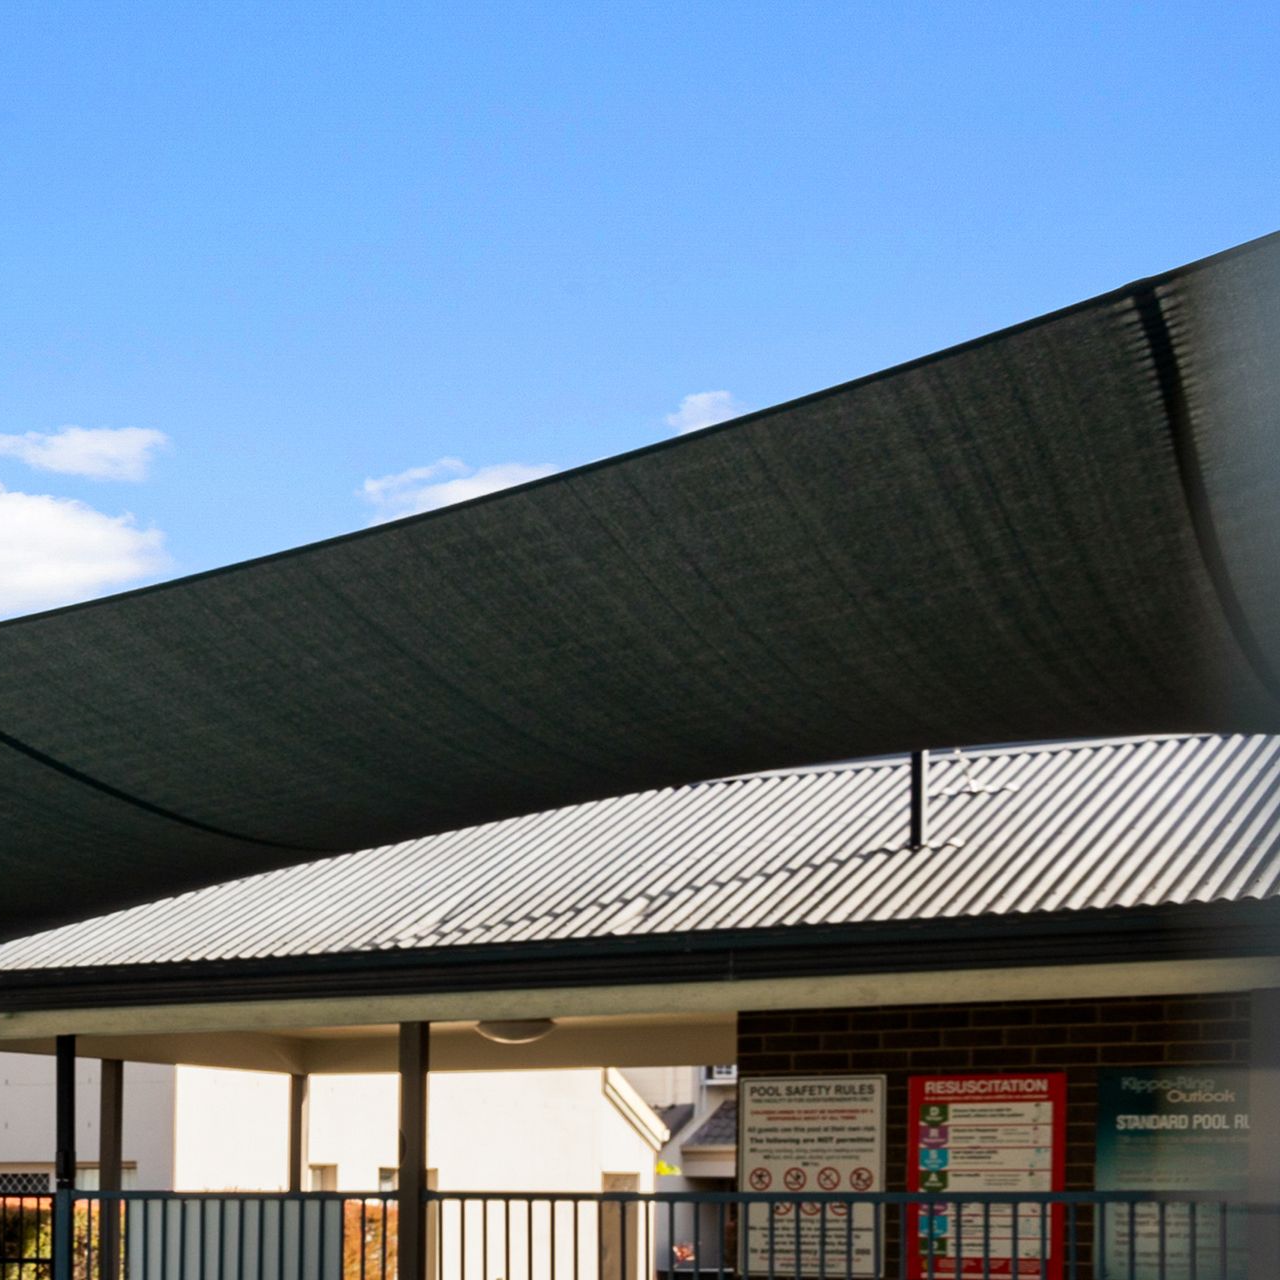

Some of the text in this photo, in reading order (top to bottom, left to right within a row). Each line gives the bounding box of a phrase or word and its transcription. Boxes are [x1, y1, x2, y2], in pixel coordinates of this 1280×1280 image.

[749, 1084, 875, 1096] POOL SAFETY RULES
[924, 1078, 1048, 1094] RESUSCITATION
[1166, 1089, 1235, 1103] Outlook
[1115, 1114, 1189, 1130] STANDARD
[1192, 1113, 1230, 1130] POOL
